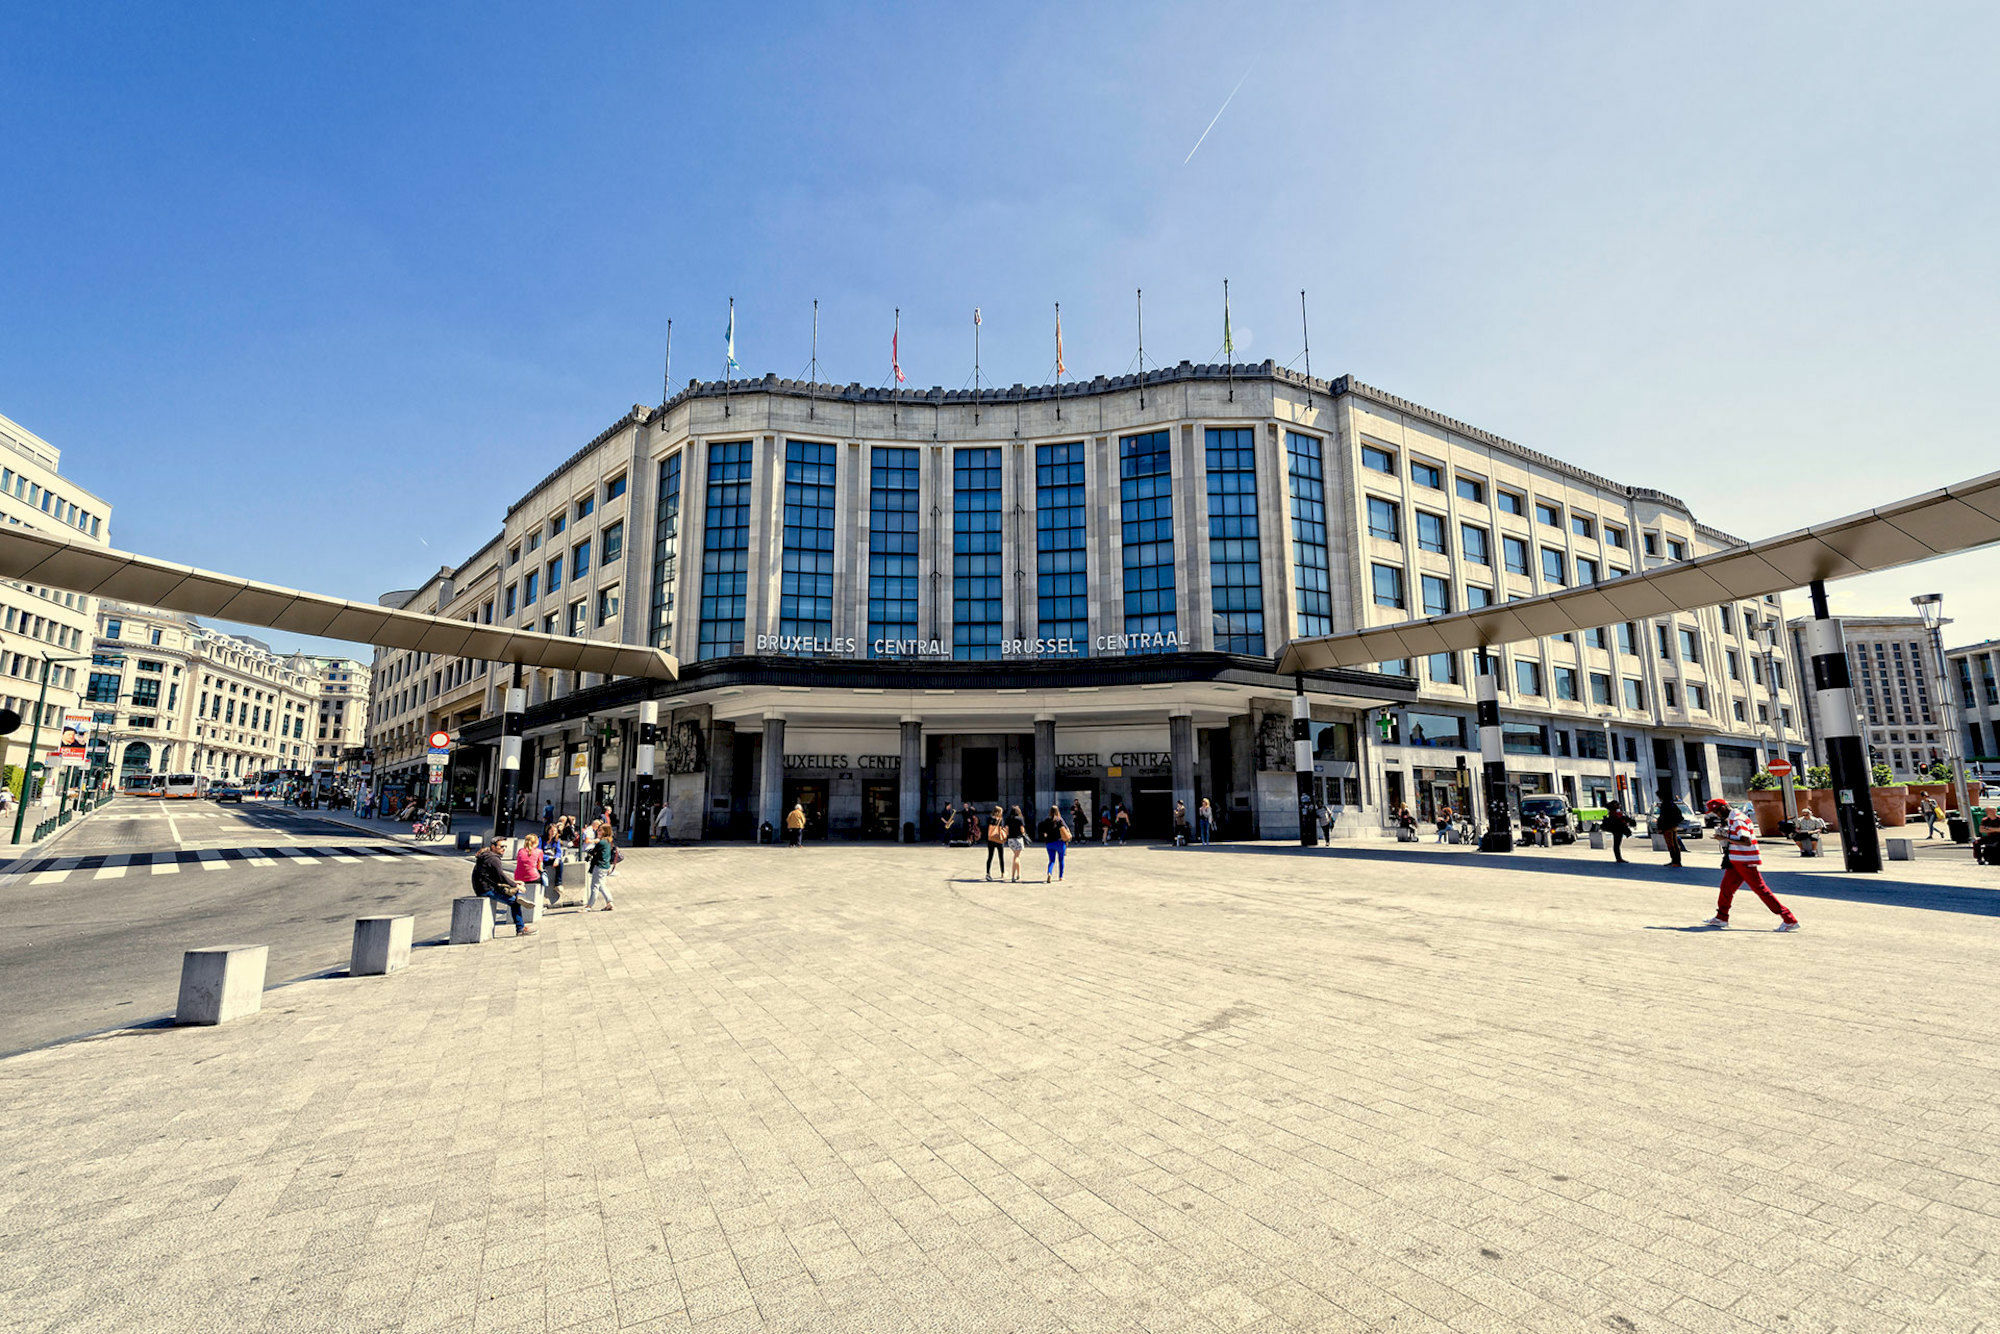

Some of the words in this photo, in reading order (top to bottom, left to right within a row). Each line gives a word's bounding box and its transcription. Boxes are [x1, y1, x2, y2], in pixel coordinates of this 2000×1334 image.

[757, 634, 855, 652] BRUXELLES
[874, 639, 949, 655] CENTRAL
[1001, 638, 1078, 654] BRUSSEL
[1096, 631, 1189, 650] CENTRAAL
[783, 754, 848, 769] UXELLES
[858, 755, 900, 769] CENTR
[1055, 753, 1102, 767] USSEL
[1110, 752, 1171, 767] CENTRA
